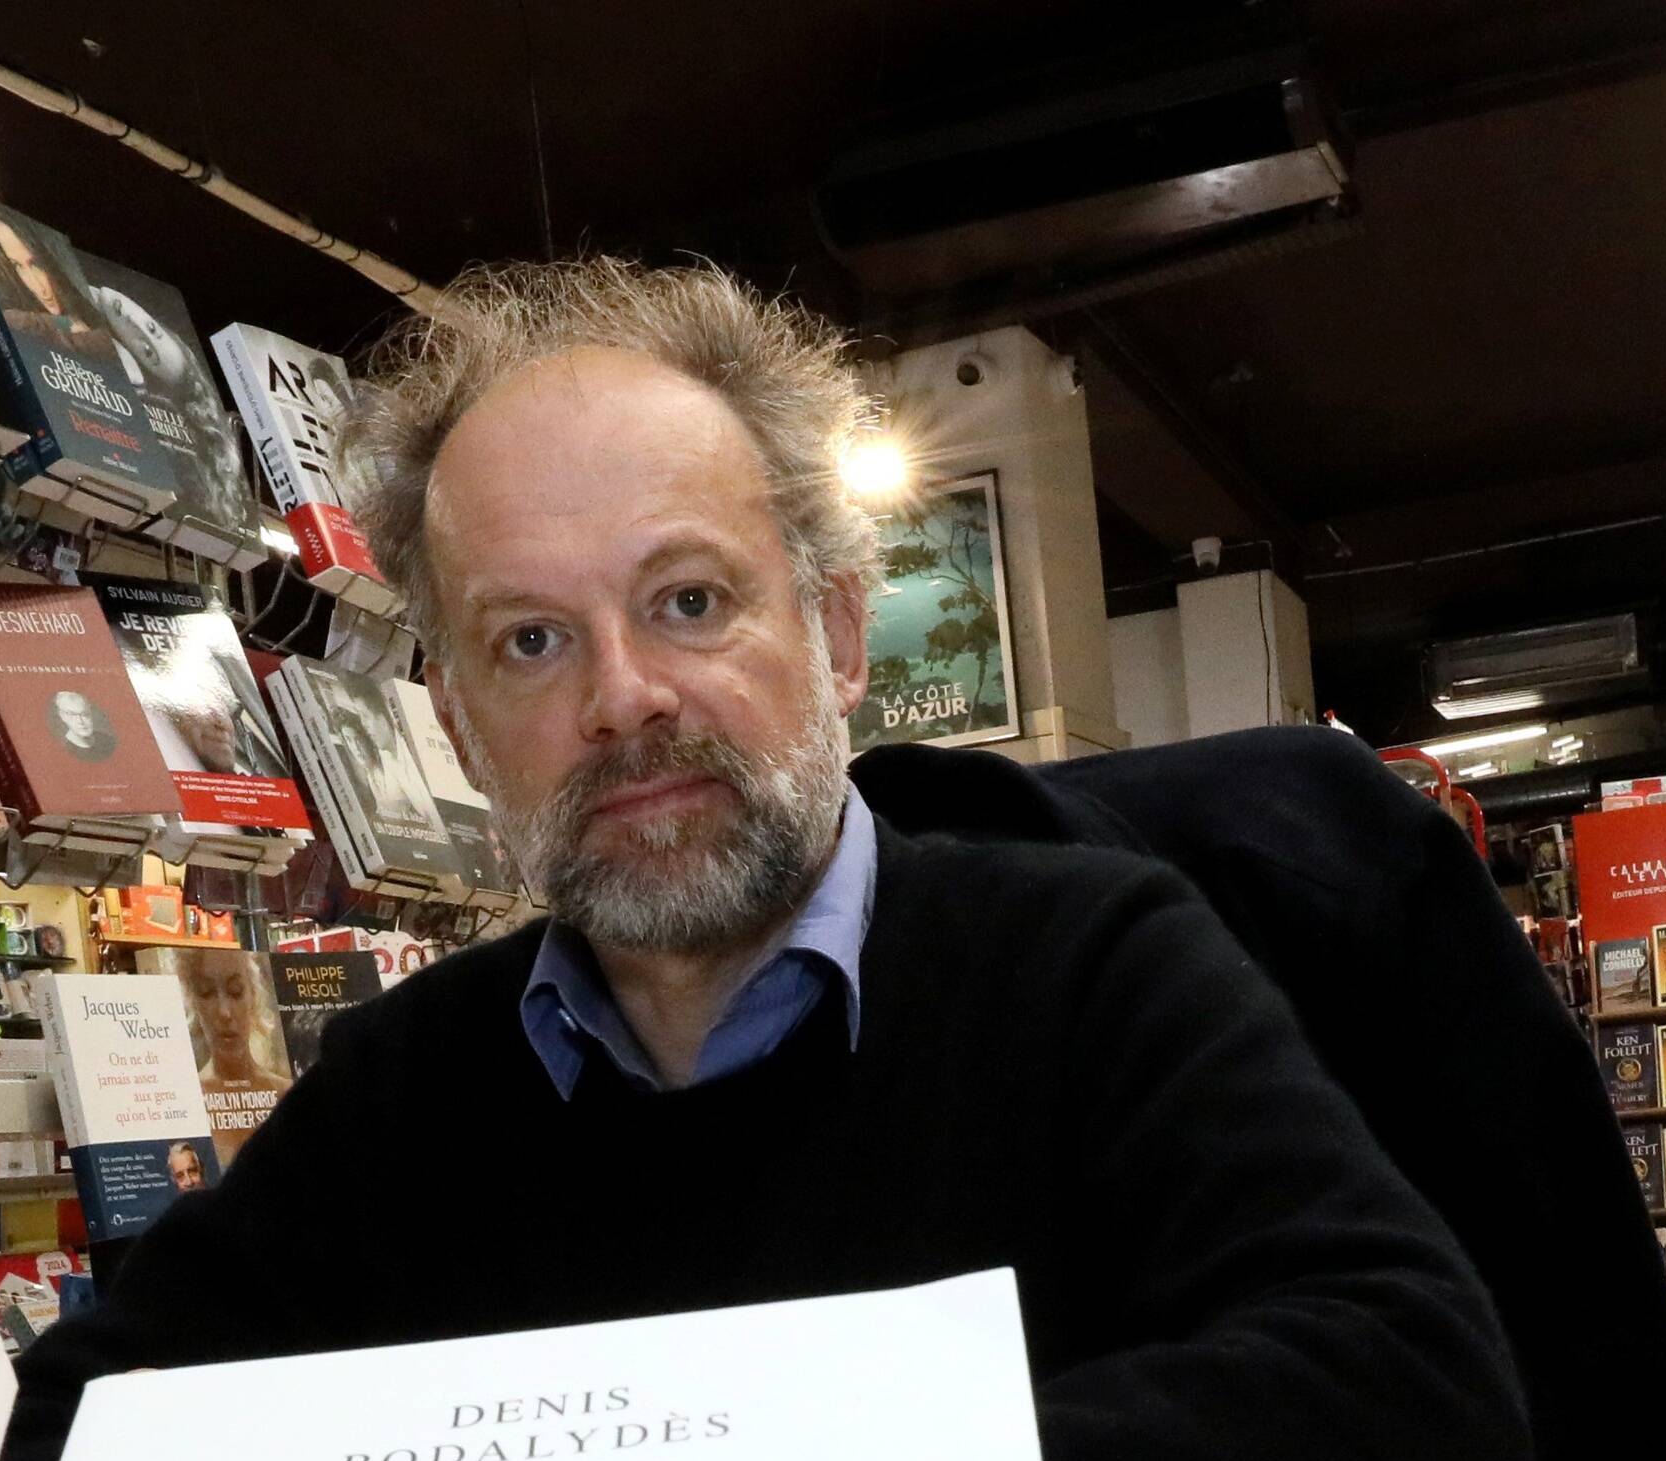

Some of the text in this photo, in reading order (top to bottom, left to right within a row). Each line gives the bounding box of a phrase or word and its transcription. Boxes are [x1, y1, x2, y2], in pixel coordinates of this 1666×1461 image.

[49, 350, 107, 388] Hélène
[41, 365, 133, 417] GRIMAUD
[107, 586, 205, 609] SYLVAIN AUGIER
[119, 611, 144, 631] JE
[881, 681, 964, 710] LA CÔTE
[882, 696, 969, 730] D'AZUR
[1603, 956, 1646, 972] CONNELLY
[1604, 948, 1642, 961] MICHAEL
[285, 965, 347, 983] PHILIPPE
[297, 983, 342, 999] RISOLI
[82, 995, 140, 1022] Jacques
[119, 1019, 170, 1040] Weber
[1616, 1035, 1640, 1047] KEN
[108, 1050, 160, 1066] On ne dit
[1604, 1043, 1653, 1060] FOLLETT
[98, 1072, 158, 1090] jamais assez
[134, 1090, 177, 1107] aux gens
[116, 1106, 189, 1128] qu'on les aime
[217, 1110, 255, 1130] DERNIER
[452, 1385, 632, 1429] DENIS
